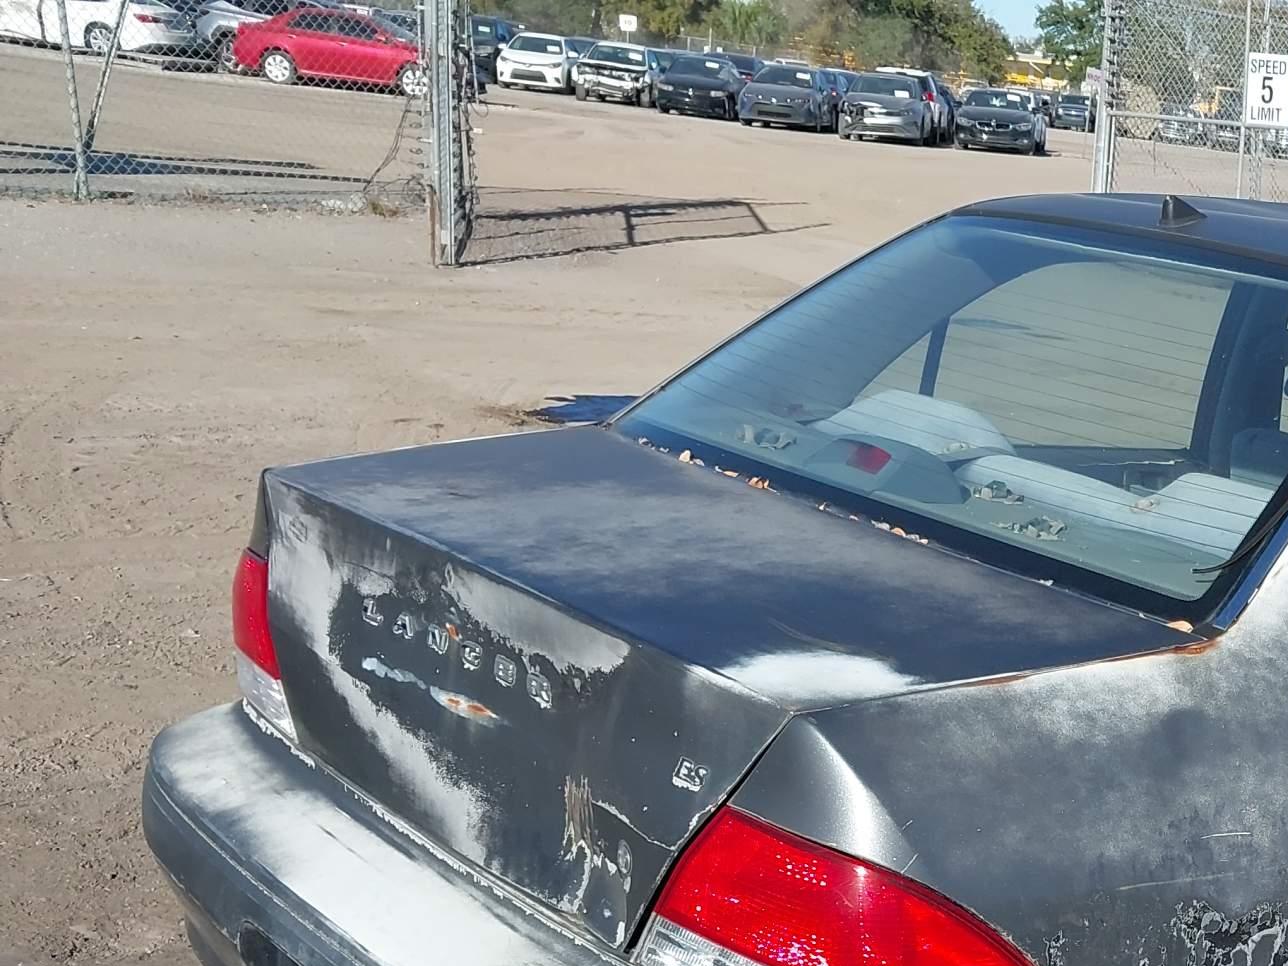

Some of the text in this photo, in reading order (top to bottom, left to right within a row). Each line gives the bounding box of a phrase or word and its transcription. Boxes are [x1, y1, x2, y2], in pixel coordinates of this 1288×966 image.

[1250, 58, 1287, 75] SPEED
[1261, 76, 1273, 104] 5
[1250, 106, 1283, 122] LIMIT
[361, 598, 553, 709] LANCER
[672, 755, 710, 792] ES
